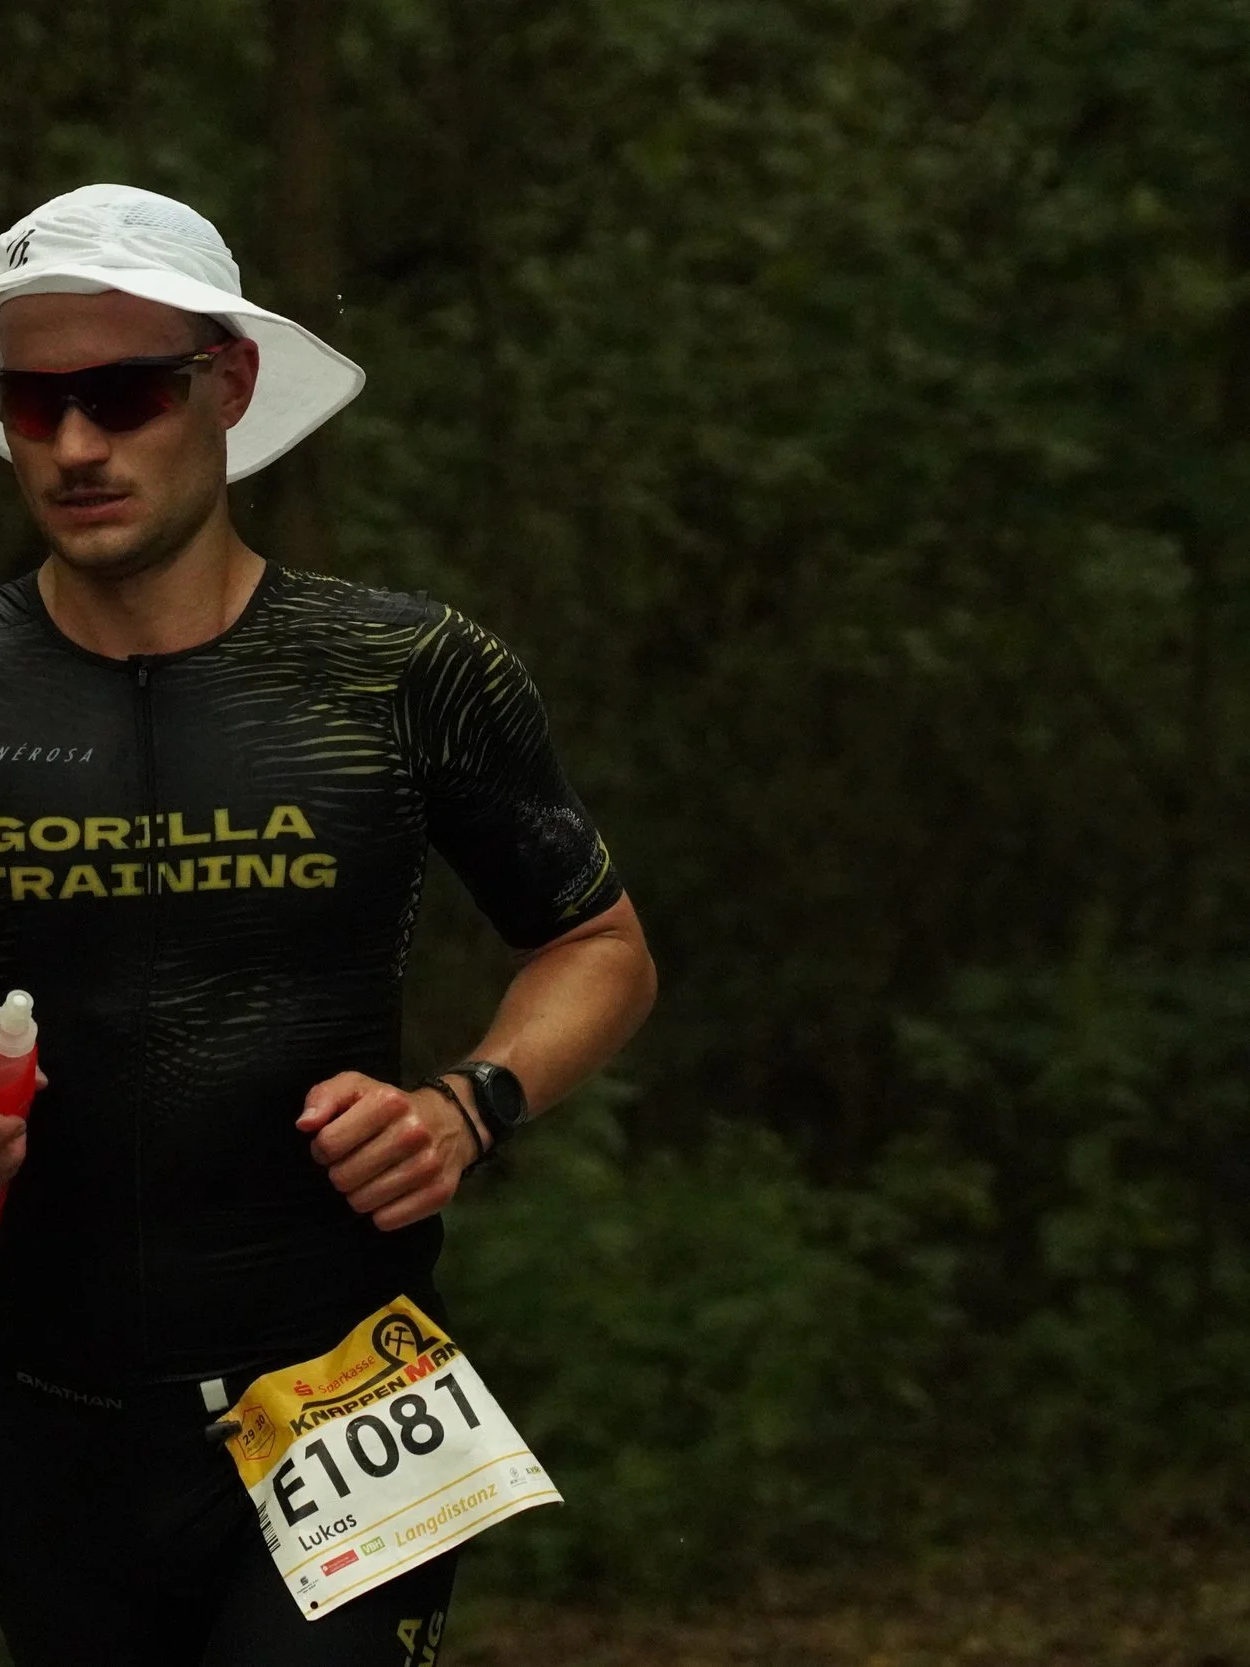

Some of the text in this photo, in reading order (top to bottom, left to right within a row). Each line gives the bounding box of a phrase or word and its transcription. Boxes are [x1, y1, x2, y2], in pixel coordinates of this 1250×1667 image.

[318, 1354, 376, 1394] Sparkasse
[272, 1373, 482, 1527] E1081
[298, 1514, 357, 1551] Lukas
[395, 1483, 496, 1546] Langdistanz
